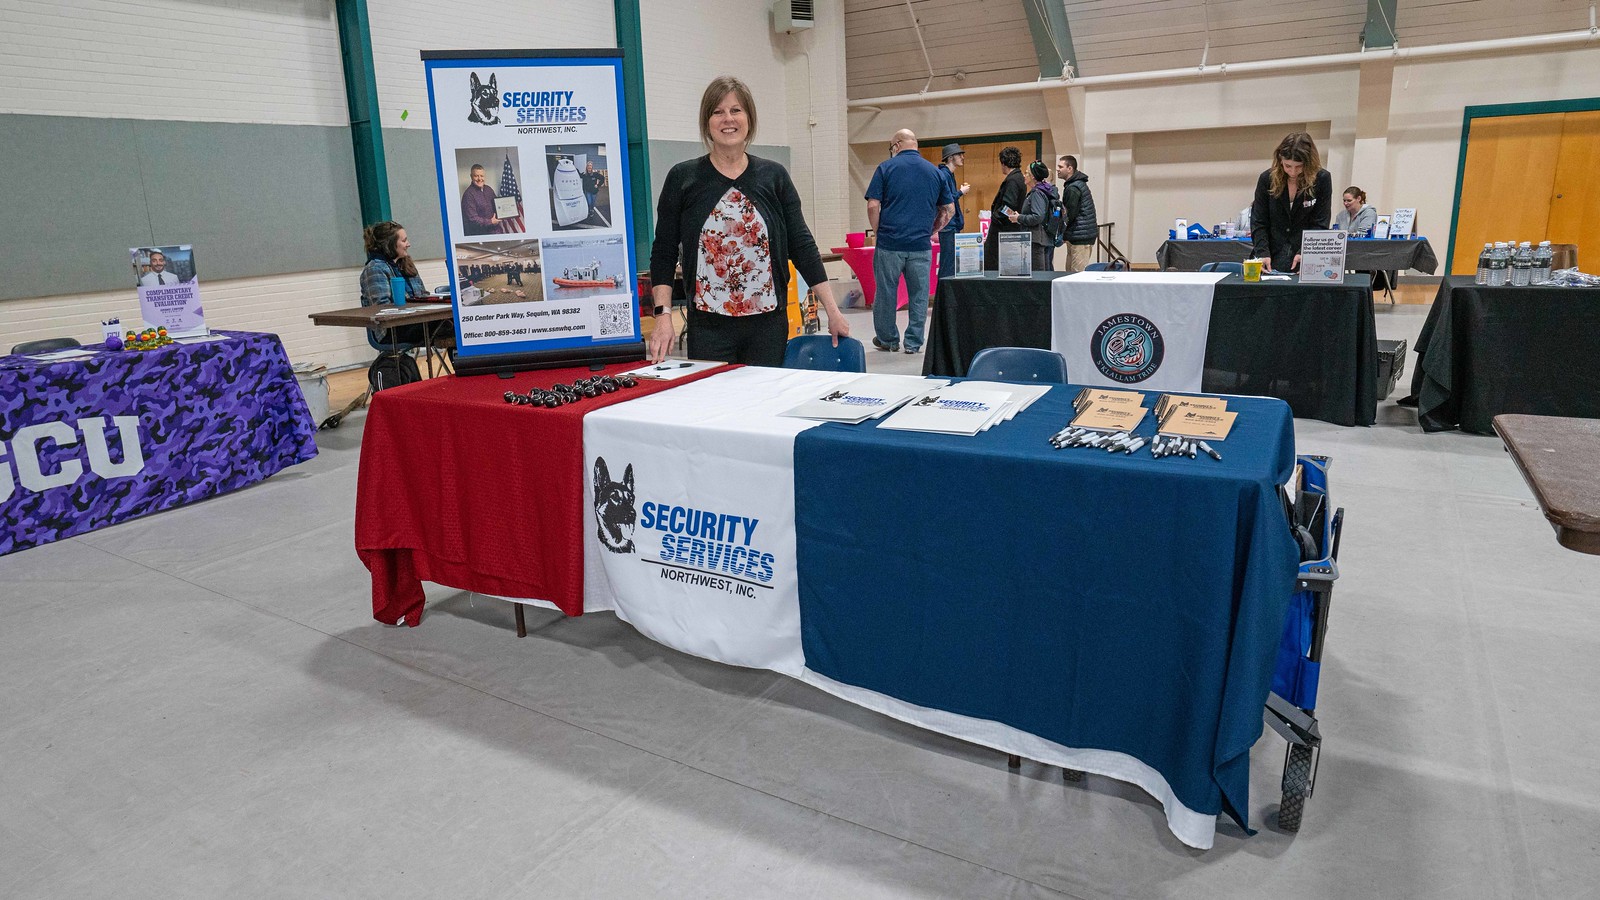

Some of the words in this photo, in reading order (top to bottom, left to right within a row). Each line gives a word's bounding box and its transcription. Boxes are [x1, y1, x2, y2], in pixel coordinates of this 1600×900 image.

[502, 91, 574, 108] SECURITY
[516, 106, 587, 124] SERVICES
[517, 126, 563, 135] NORTHWEST,
[563, 125, 578, 133] INC.
[145, 287, 192, 297] COMPLIMENTARY
[526, 310, 550, 318] Sequim,
[463, 331, 484, 339] Office:
[484, 328, 527, 337] 800-859-3463
[531, 324, 586, 334] www.ssnwhq.com
[1097, 315, 1159, 339] JAMESTOWN
[1096, 360, 1136, 382] S'KLALLAM
[1137, 362, 1158, 380] TRIBE
[0, 415, 145, 500] CU
[640, 501, 760, 546] SECURITY
[660, 533, 775, 582] SERVICES
[660, 567, 733, 595] NORTHWEST,
[735, 583, 757, 599] INC.
